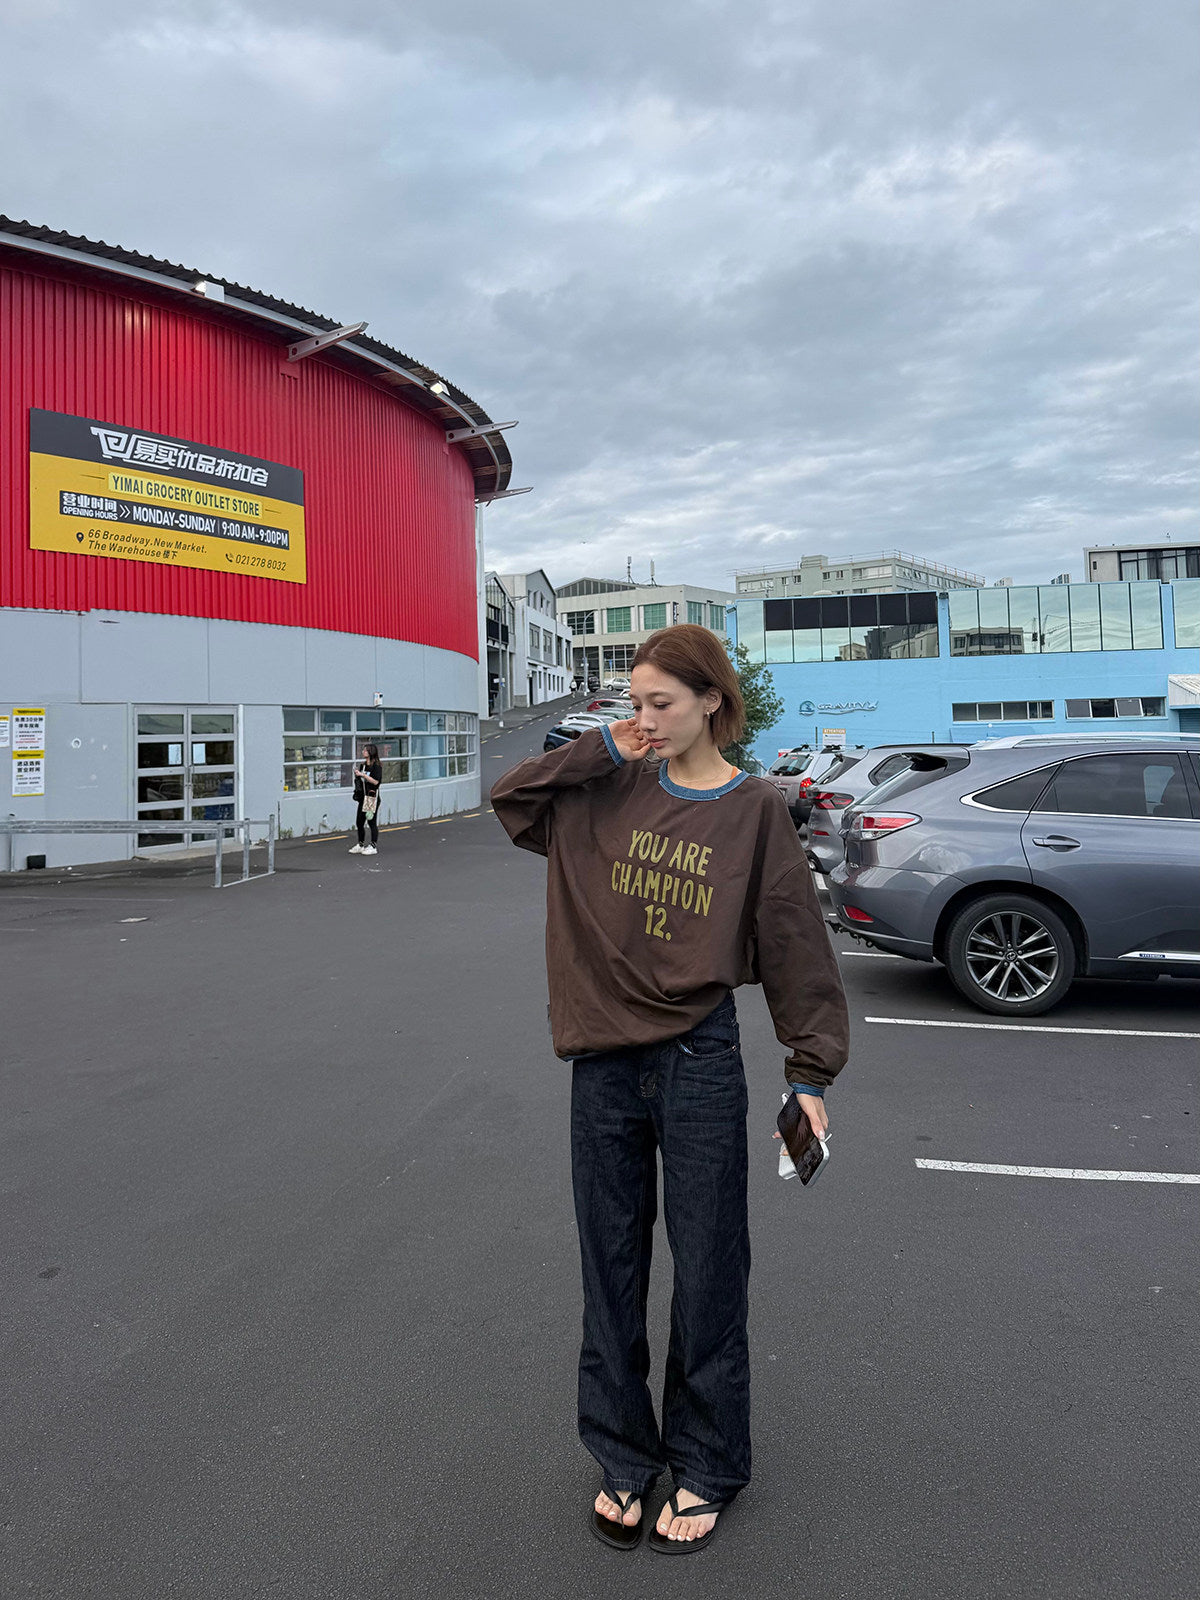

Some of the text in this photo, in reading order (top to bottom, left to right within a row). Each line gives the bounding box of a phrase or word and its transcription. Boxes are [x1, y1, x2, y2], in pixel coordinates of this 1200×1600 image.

[62, 492, 117, 512] 营业时间
[112, 475, 260, 517] YIMAI GROCERY OUTLET STORE
[62, 505, 118, 521] OPENING HOURS
[132, 505, 216, 534] MONDAY-SUNDAY
[88, 528, 101, 539] 66
[88, 540, 107, 551] The
[108, 542, 161, 558] Warehouse
[628, 829, 713, 877] YOU ARE
[611, 860, 714, 917] CHAMPION
[644, 904, 672, 941] 12.
